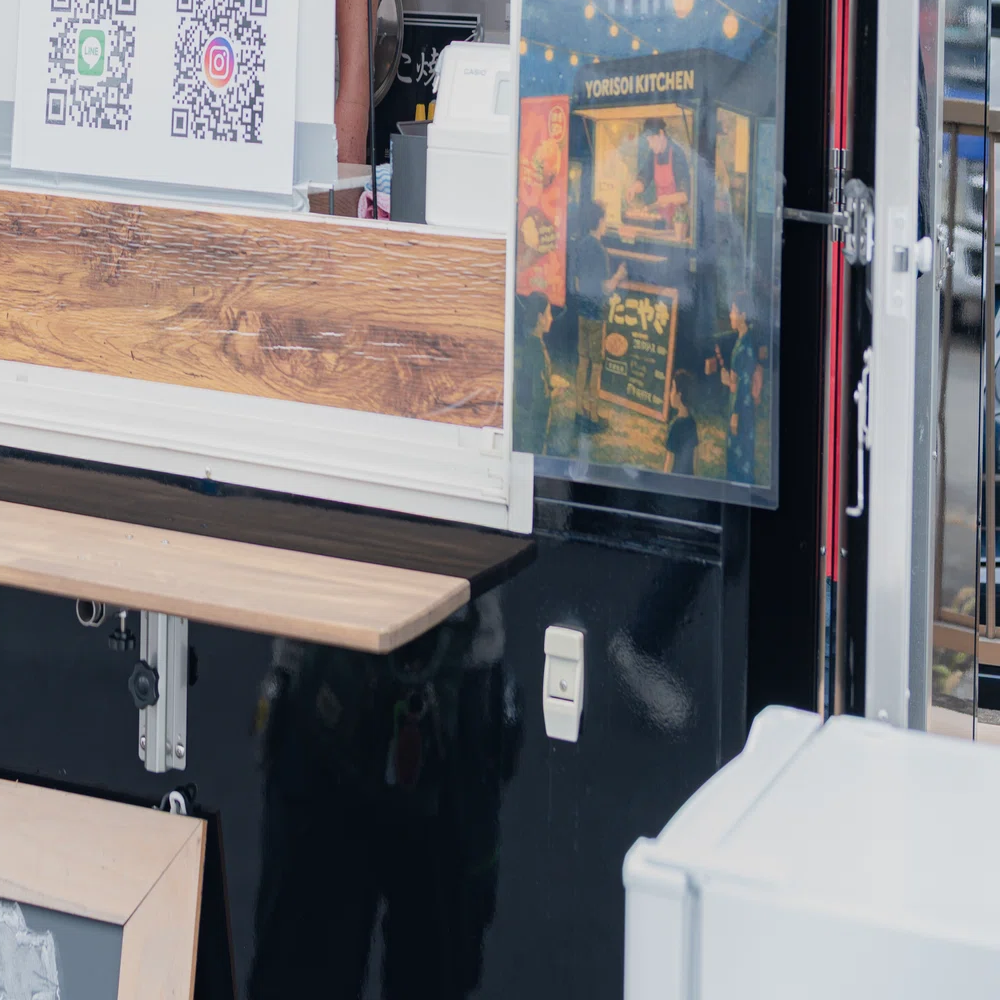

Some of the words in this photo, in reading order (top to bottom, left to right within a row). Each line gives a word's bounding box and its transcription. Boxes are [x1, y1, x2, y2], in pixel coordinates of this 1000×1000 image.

[83, 46, 99, 56] LINE
[585, 76, 633, 99] YORISOI
[635, 69, 695, 94] KITCHEN
[608, 292, 670, 335] たこやき
